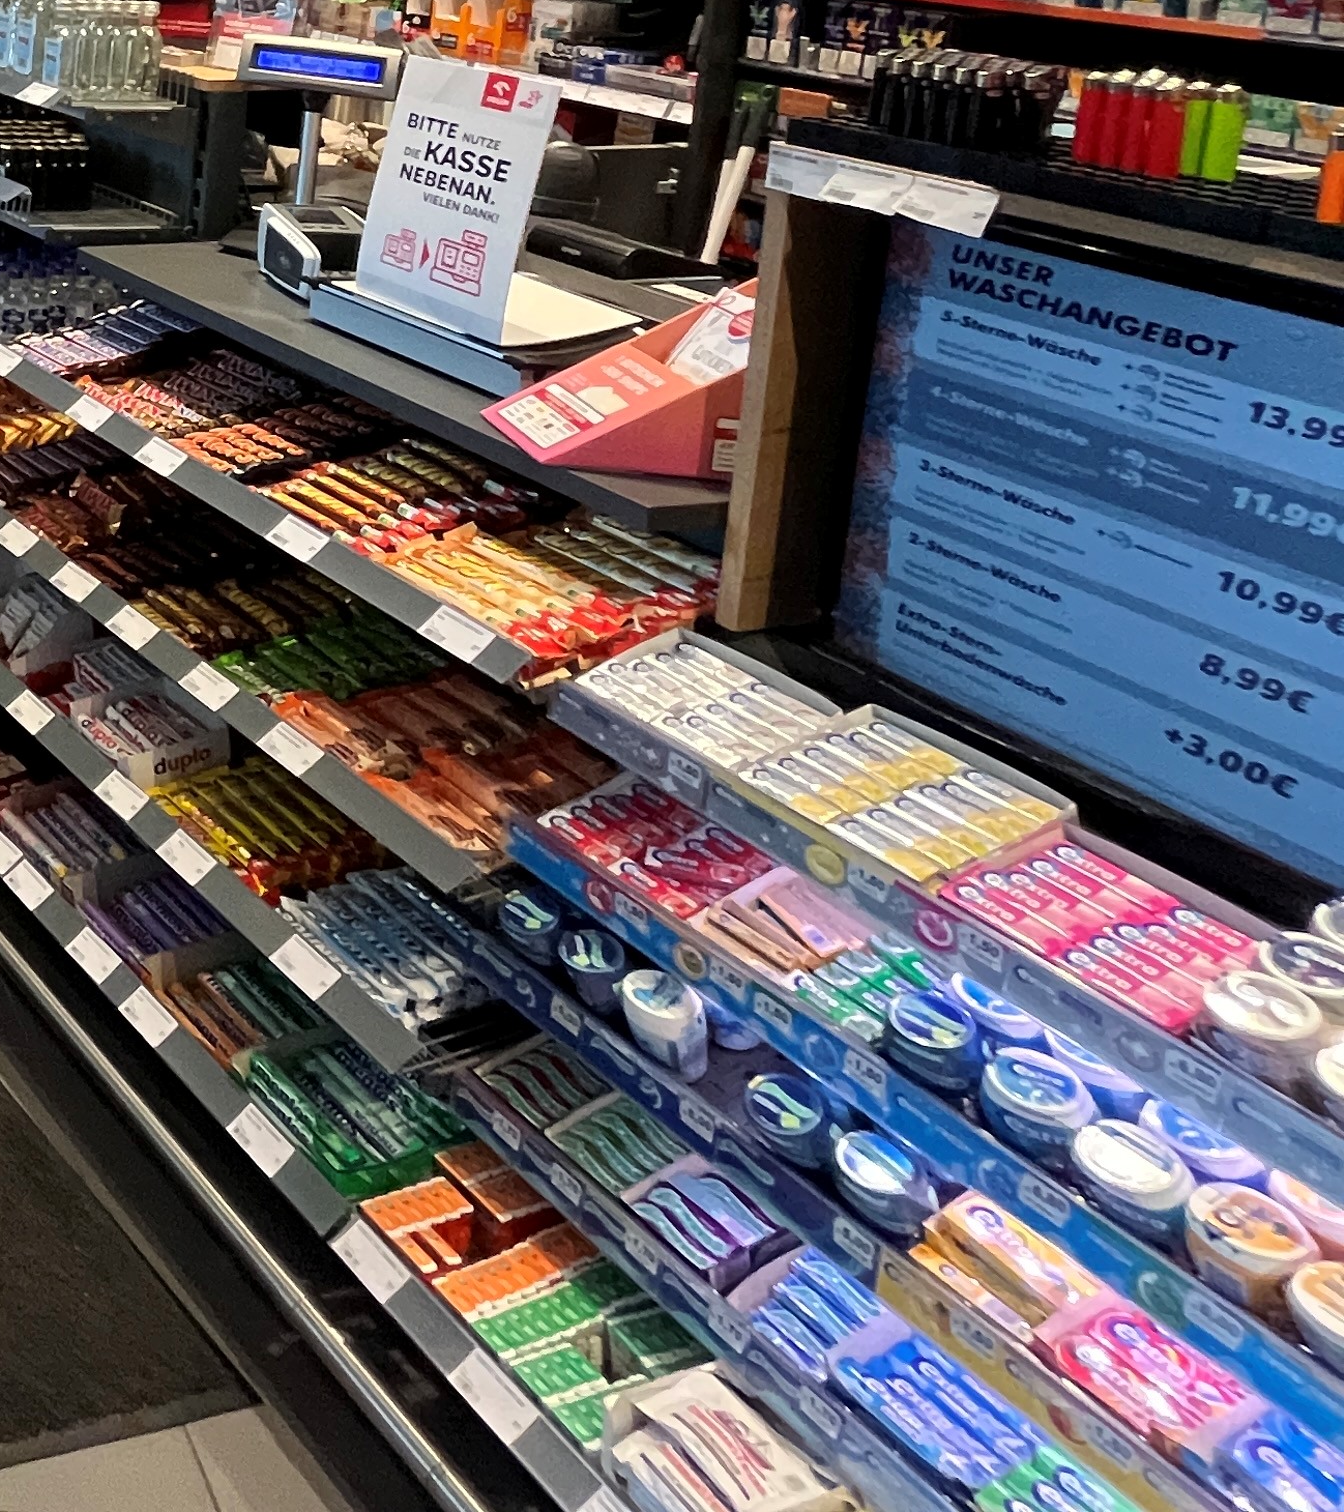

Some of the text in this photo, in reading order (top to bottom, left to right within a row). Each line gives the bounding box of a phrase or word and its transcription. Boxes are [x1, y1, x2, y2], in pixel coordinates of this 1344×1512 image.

[407, 112, 502, 152] BITTE NUTZE
[403, 139, 512, 184] DIE KASSE
[398, 163, 496, 206] NEBENAN.
[422, 191, 501, 225] VIELEN DANK!
[951, 243, 1055, 287] UNSER
[948, 268, 1241, 363] WASCHANGEBOT
[153, 746, 213, 776] duplo
